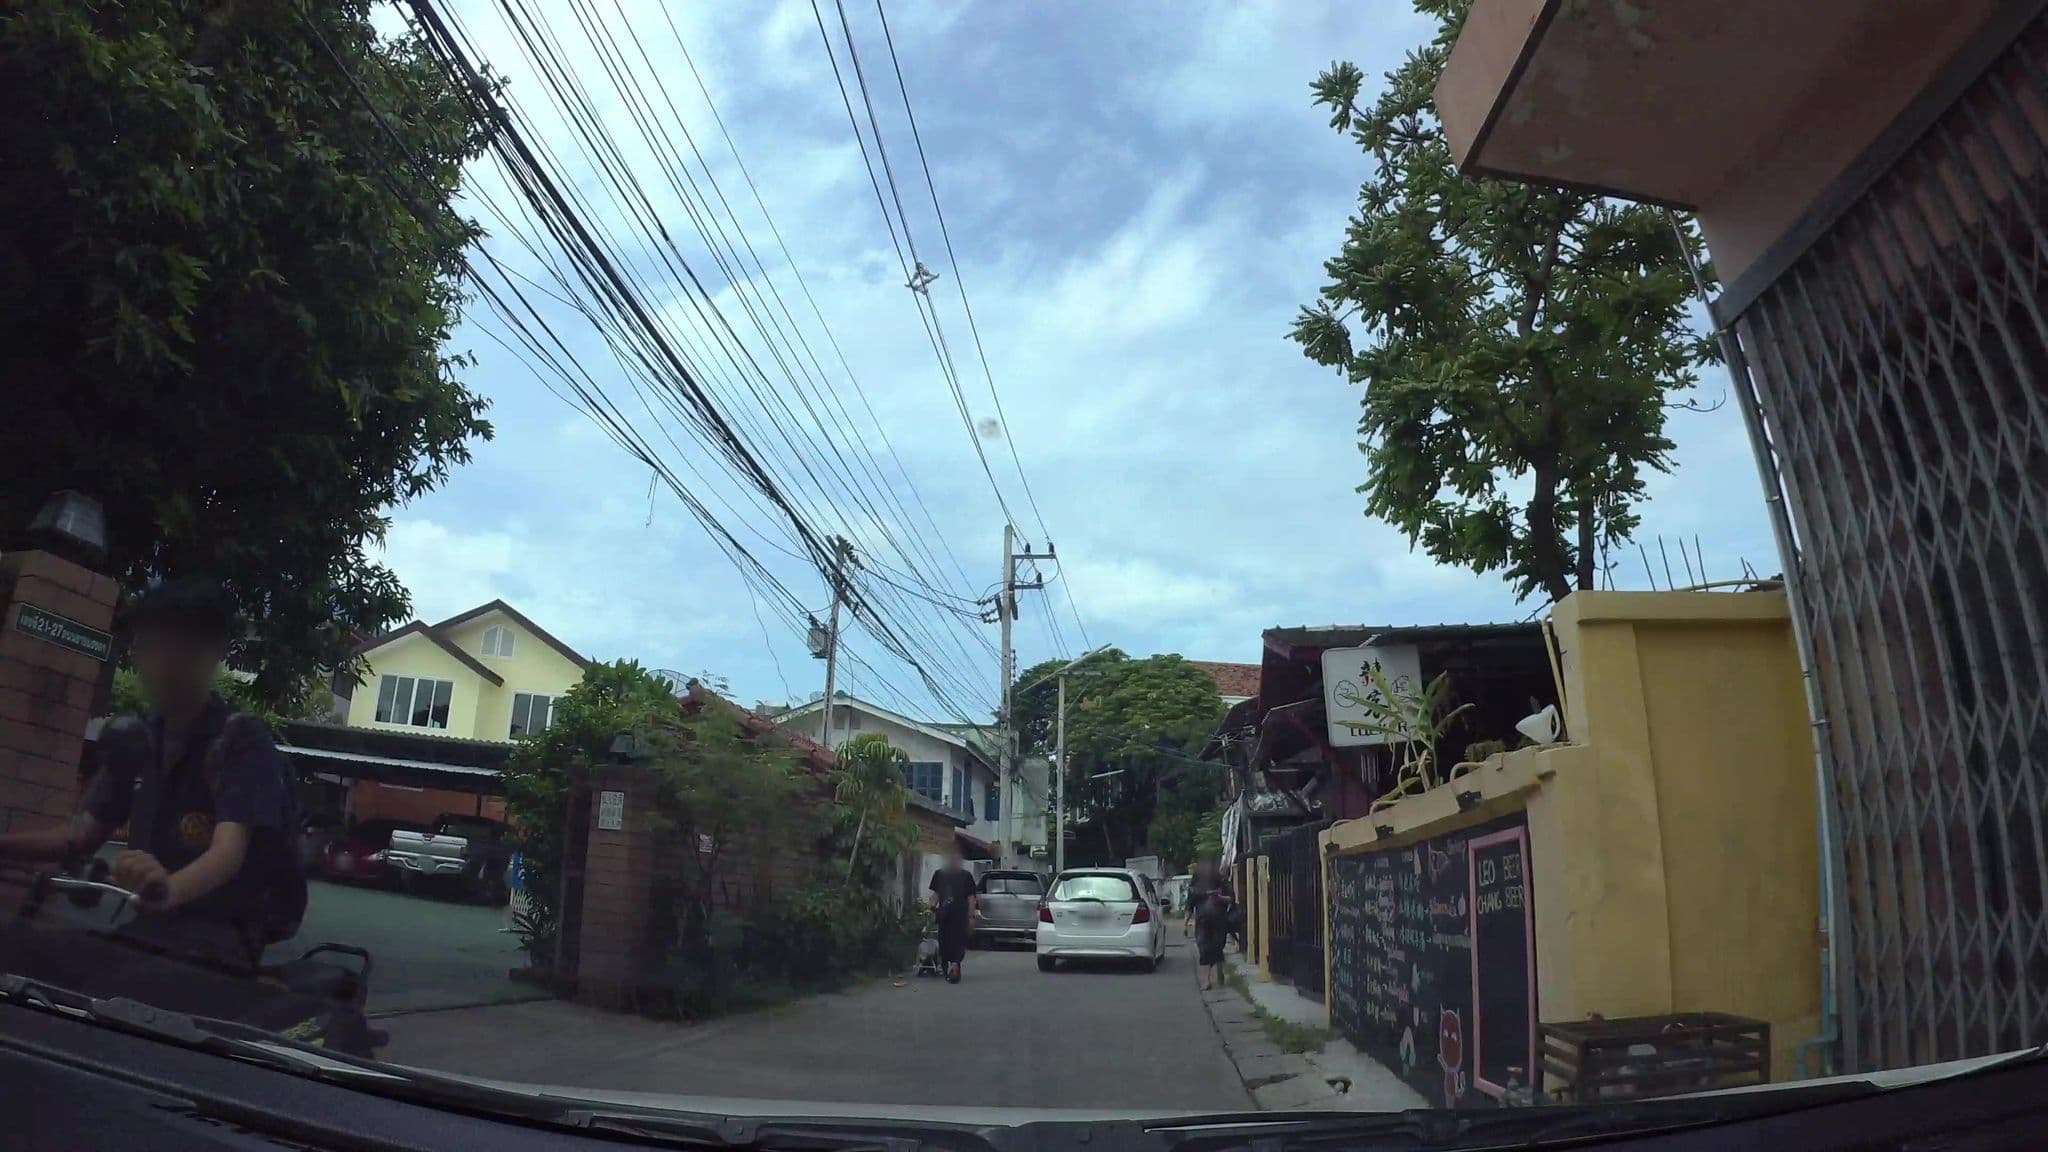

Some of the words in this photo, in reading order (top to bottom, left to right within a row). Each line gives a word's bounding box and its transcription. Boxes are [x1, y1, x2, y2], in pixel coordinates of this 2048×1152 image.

[1478, 858, 1496, 887] LEO
[1477, 892, 1502, 915] CHANG
[1505, 885, 1524, 908] BEER
